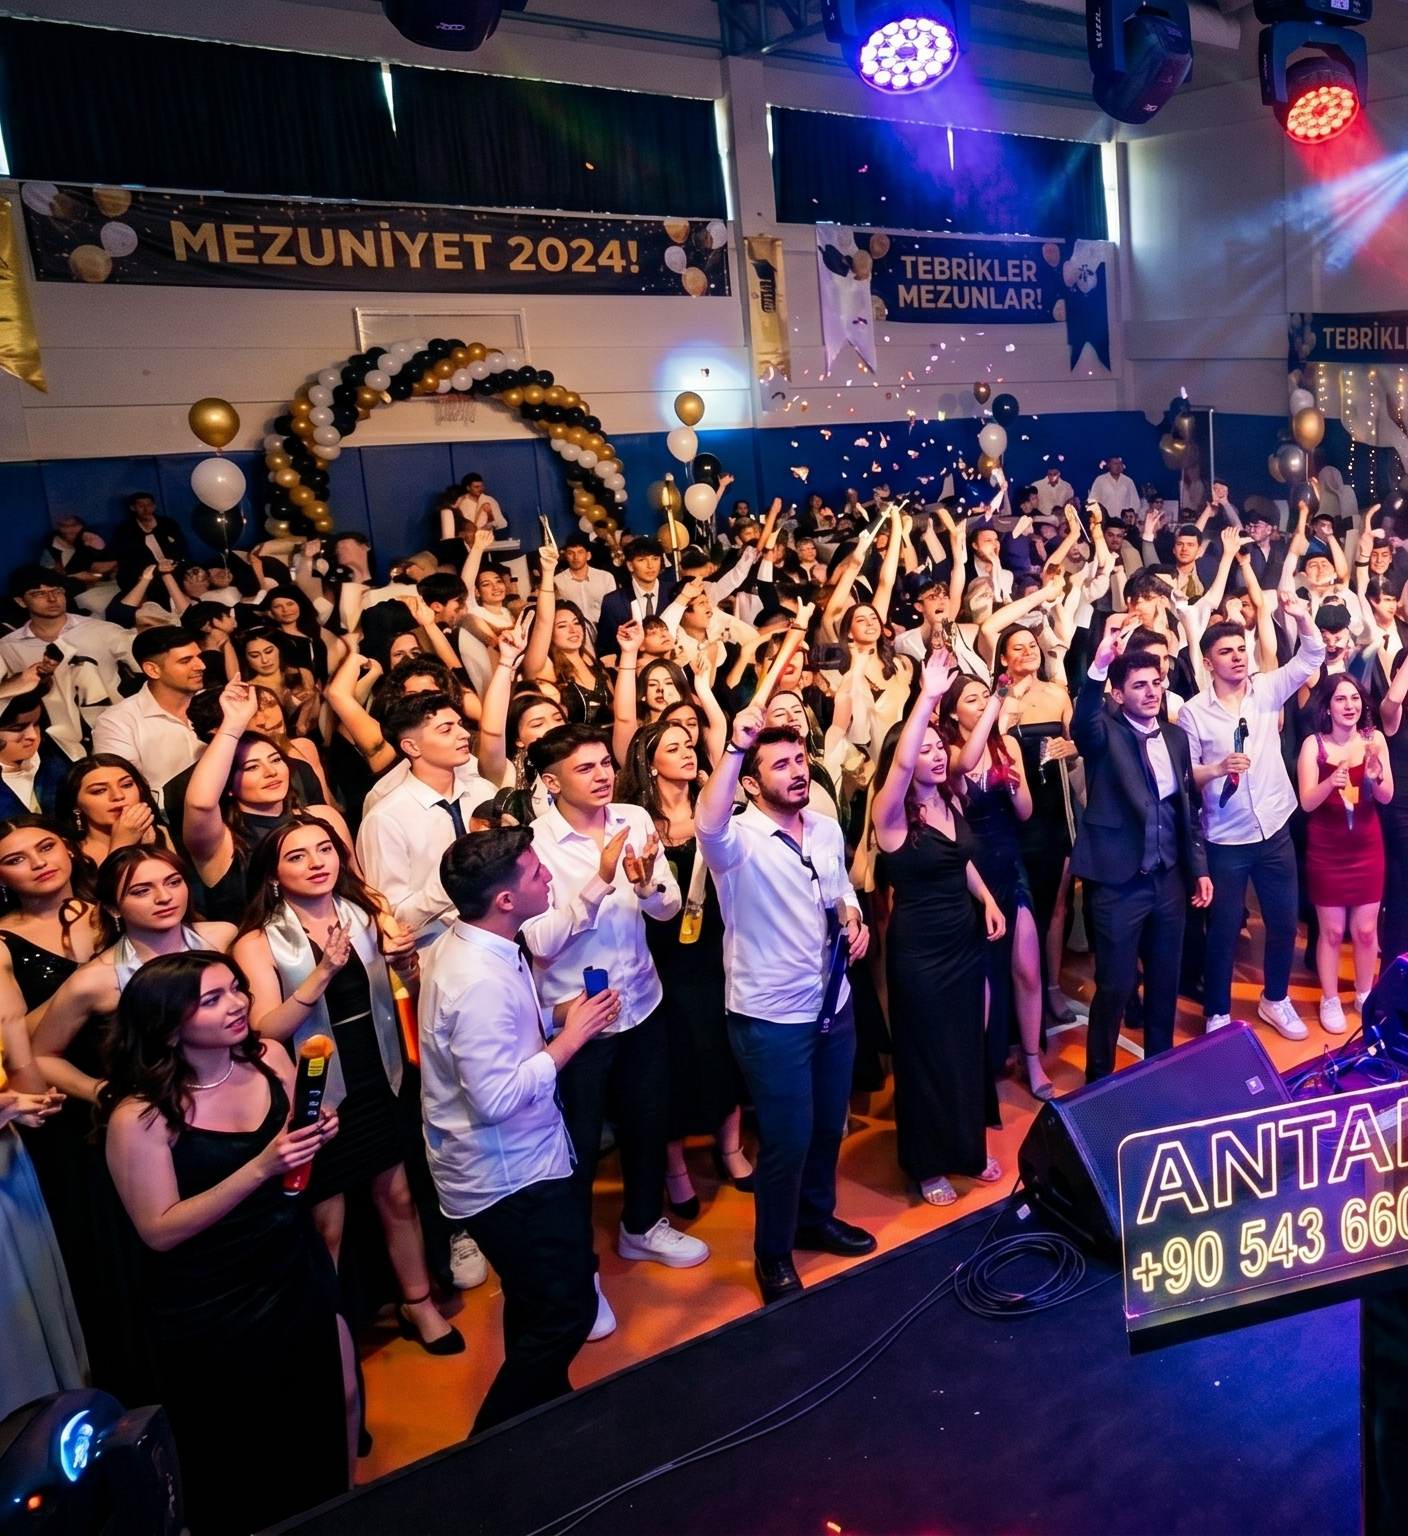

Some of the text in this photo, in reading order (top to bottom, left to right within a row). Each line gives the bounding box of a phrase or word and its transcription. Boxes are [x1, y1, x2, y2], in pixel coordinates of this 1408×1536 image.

[172, 220, 639, 273] MEZUNİYET 2024!
[900, 252, 1037, 282] TEBRİKLER
[899, 285, 1043, 310] MEZUNLAR!
[1132, 1230, 1224, 1295] +90
[1240, 1207, 1325, 1278] 543
